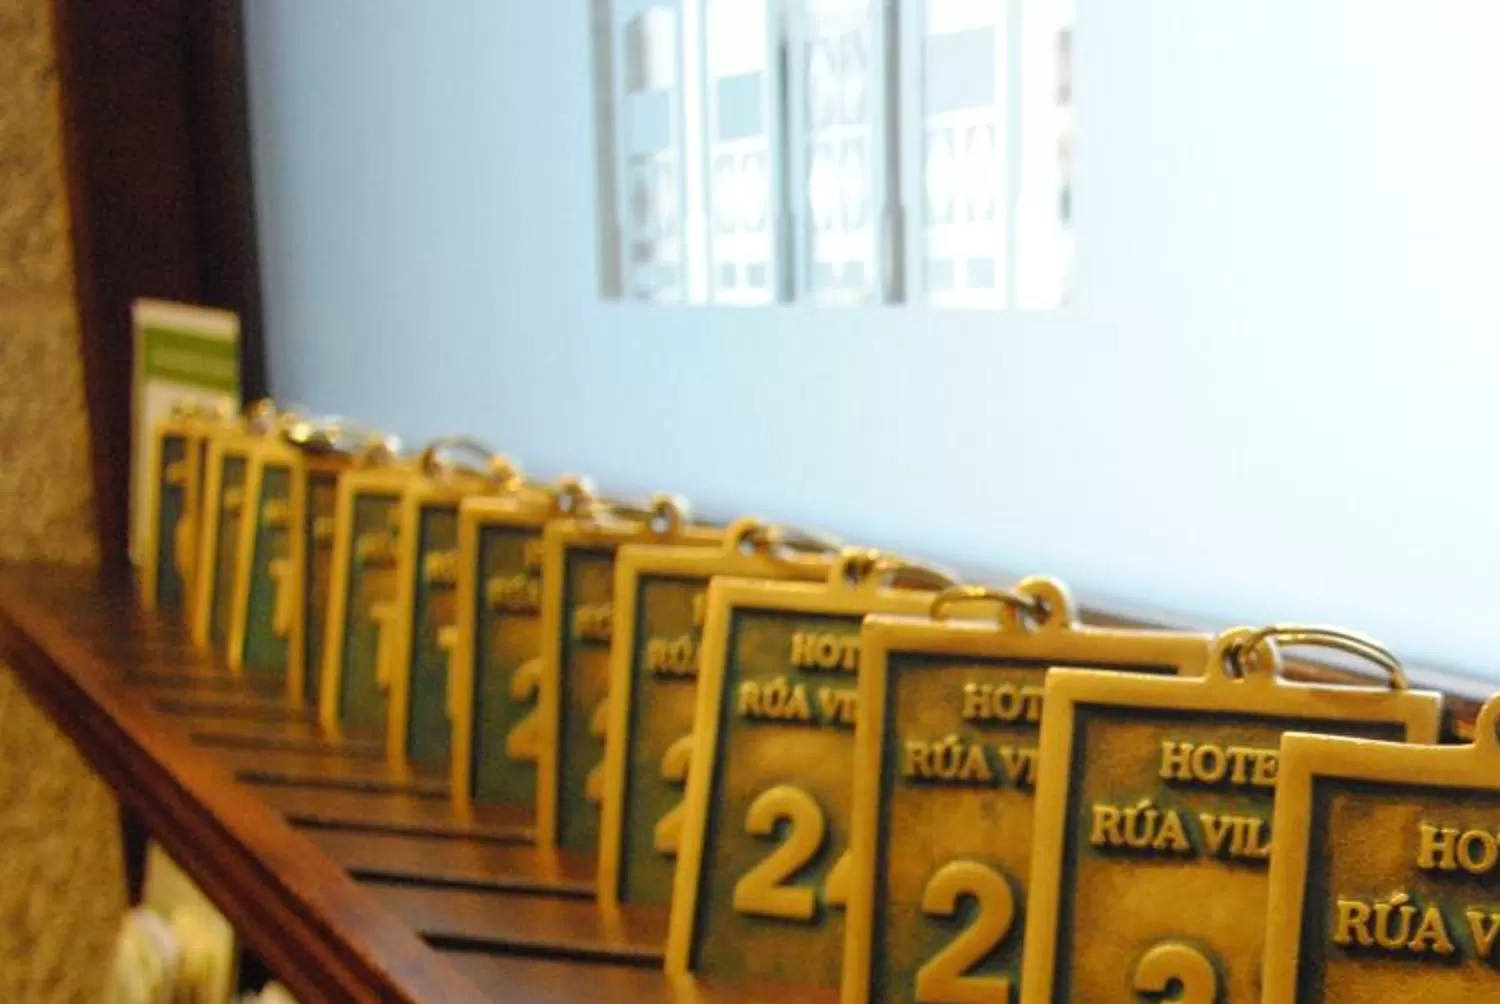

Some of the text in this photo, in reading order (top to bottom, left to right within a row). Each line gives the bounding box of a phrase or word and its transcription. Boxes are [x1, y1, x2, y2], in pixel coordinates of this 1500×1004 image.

[791, 632, 860, 670] HOT
[738, 675, 809, 720] RÚA
[963, 682, 1043, 722] HOT
[902, 733, 991, 781] RÚA
[1159, 740, 1280, 787] HOTE
[1090, 798, 1273, 857] RÚA VIL
[1333, 890, 1454, 955] RÚA
